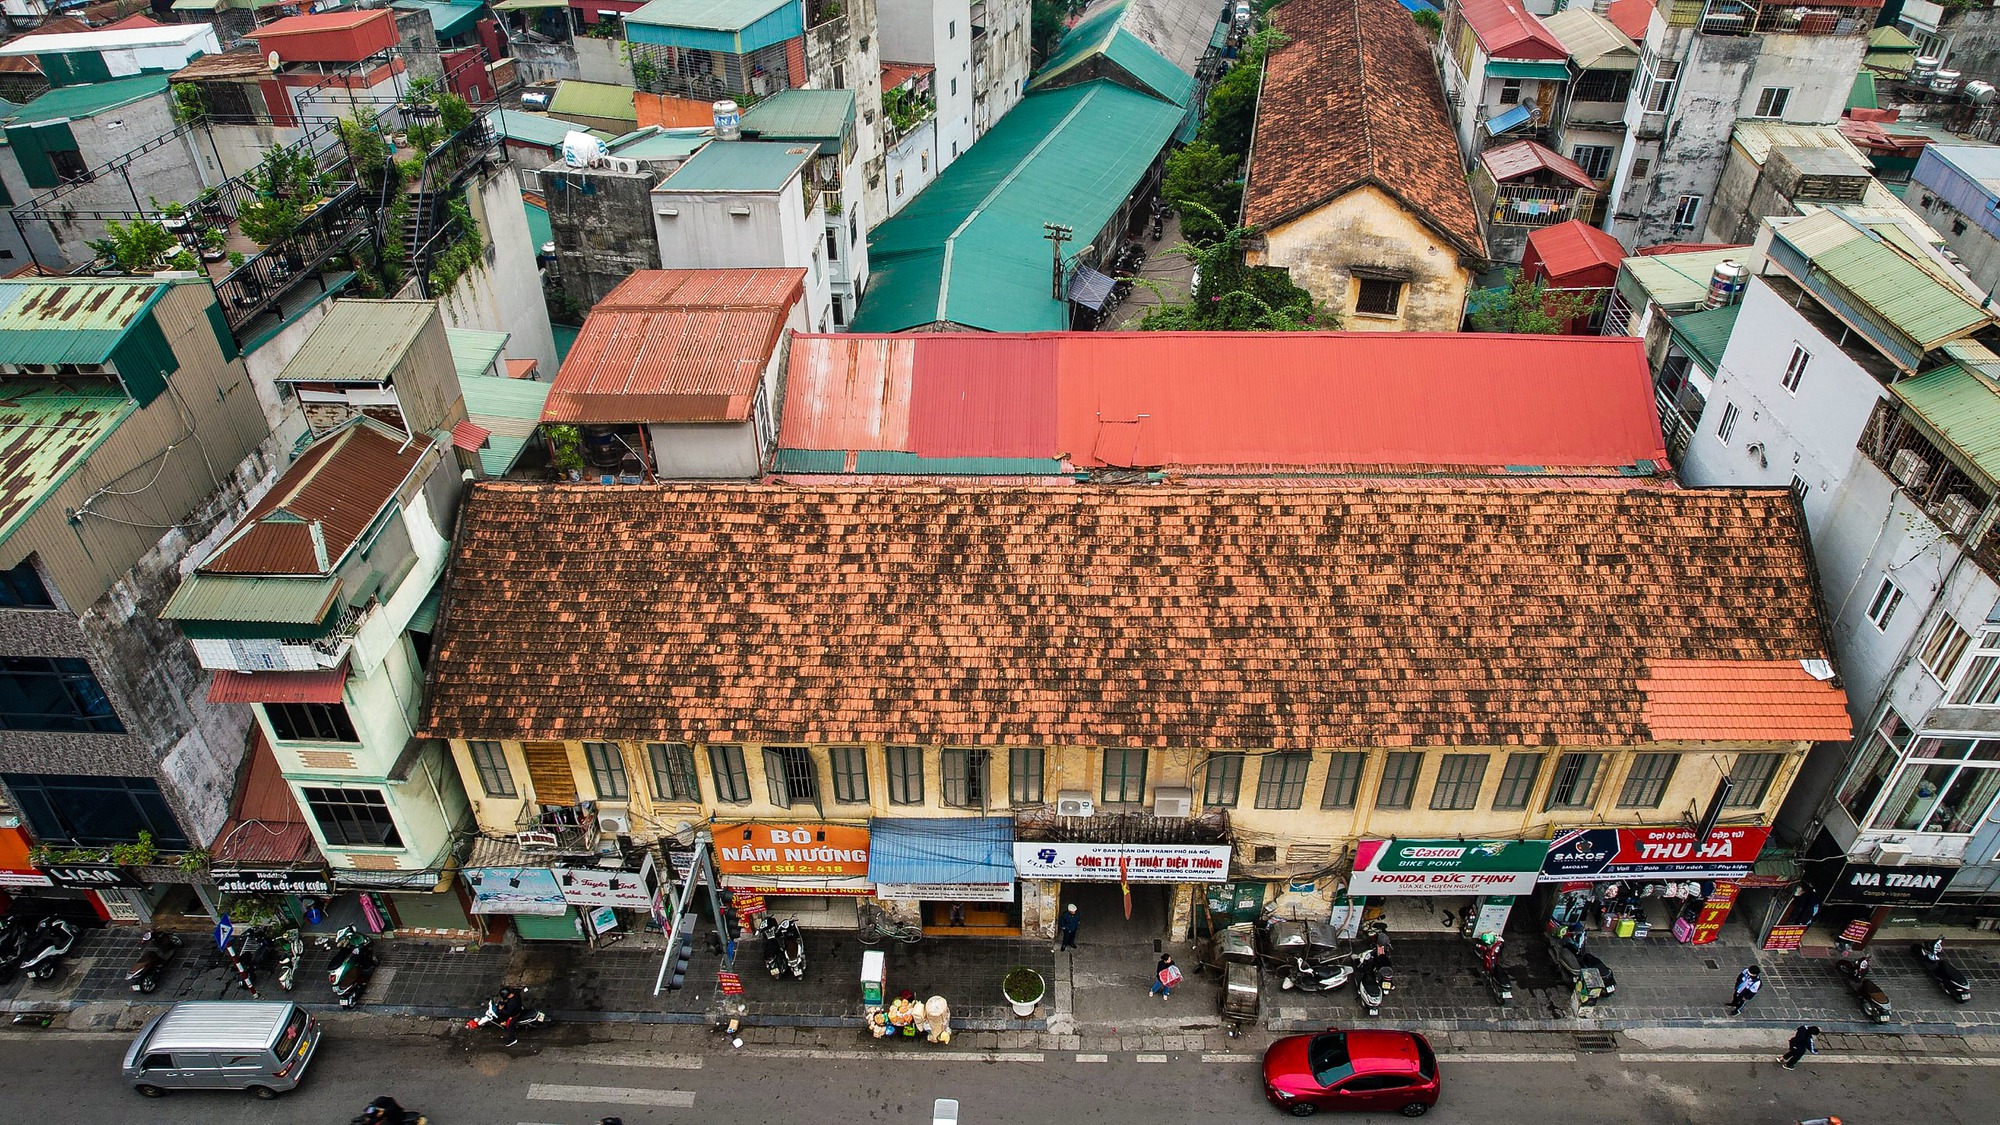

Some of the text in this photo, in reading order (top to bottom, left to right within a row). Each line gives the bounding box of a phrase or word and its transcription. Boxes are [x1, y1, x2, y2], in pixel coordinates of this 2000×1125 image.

[770, 827, 811, 844] BÒ
[1648, 832, 1665, 840] Đại
[785, 845, 867, 862] NƯỚNG
[1415, 847, 1460, 858] Castrol
[1641, 838, 1733, 858] THU HÀ
[1075, 855, 1102, 866] CÔNG
[1104, 856, 1116, 866] TY
[1134, 855, 1164, 868] THUẬT
[1166, 855, 1191, 869] ĐIỆN
[1554, 852, 1606, 860] SAKOS
[751, 864, 771, 872] CƠ
[775, 862, 795, 872] SỞ
[816, 864, 843, 873] 418
[50, 868, 121, 882] LIAM
[1370, 872, 1517, 885] HONDA ĐỨC THỊNH
[1850, 872, 1942, 889] NA THAN
[1707, 910, 1719, 921] 1
[1698, 931, 1709, 942] 1
